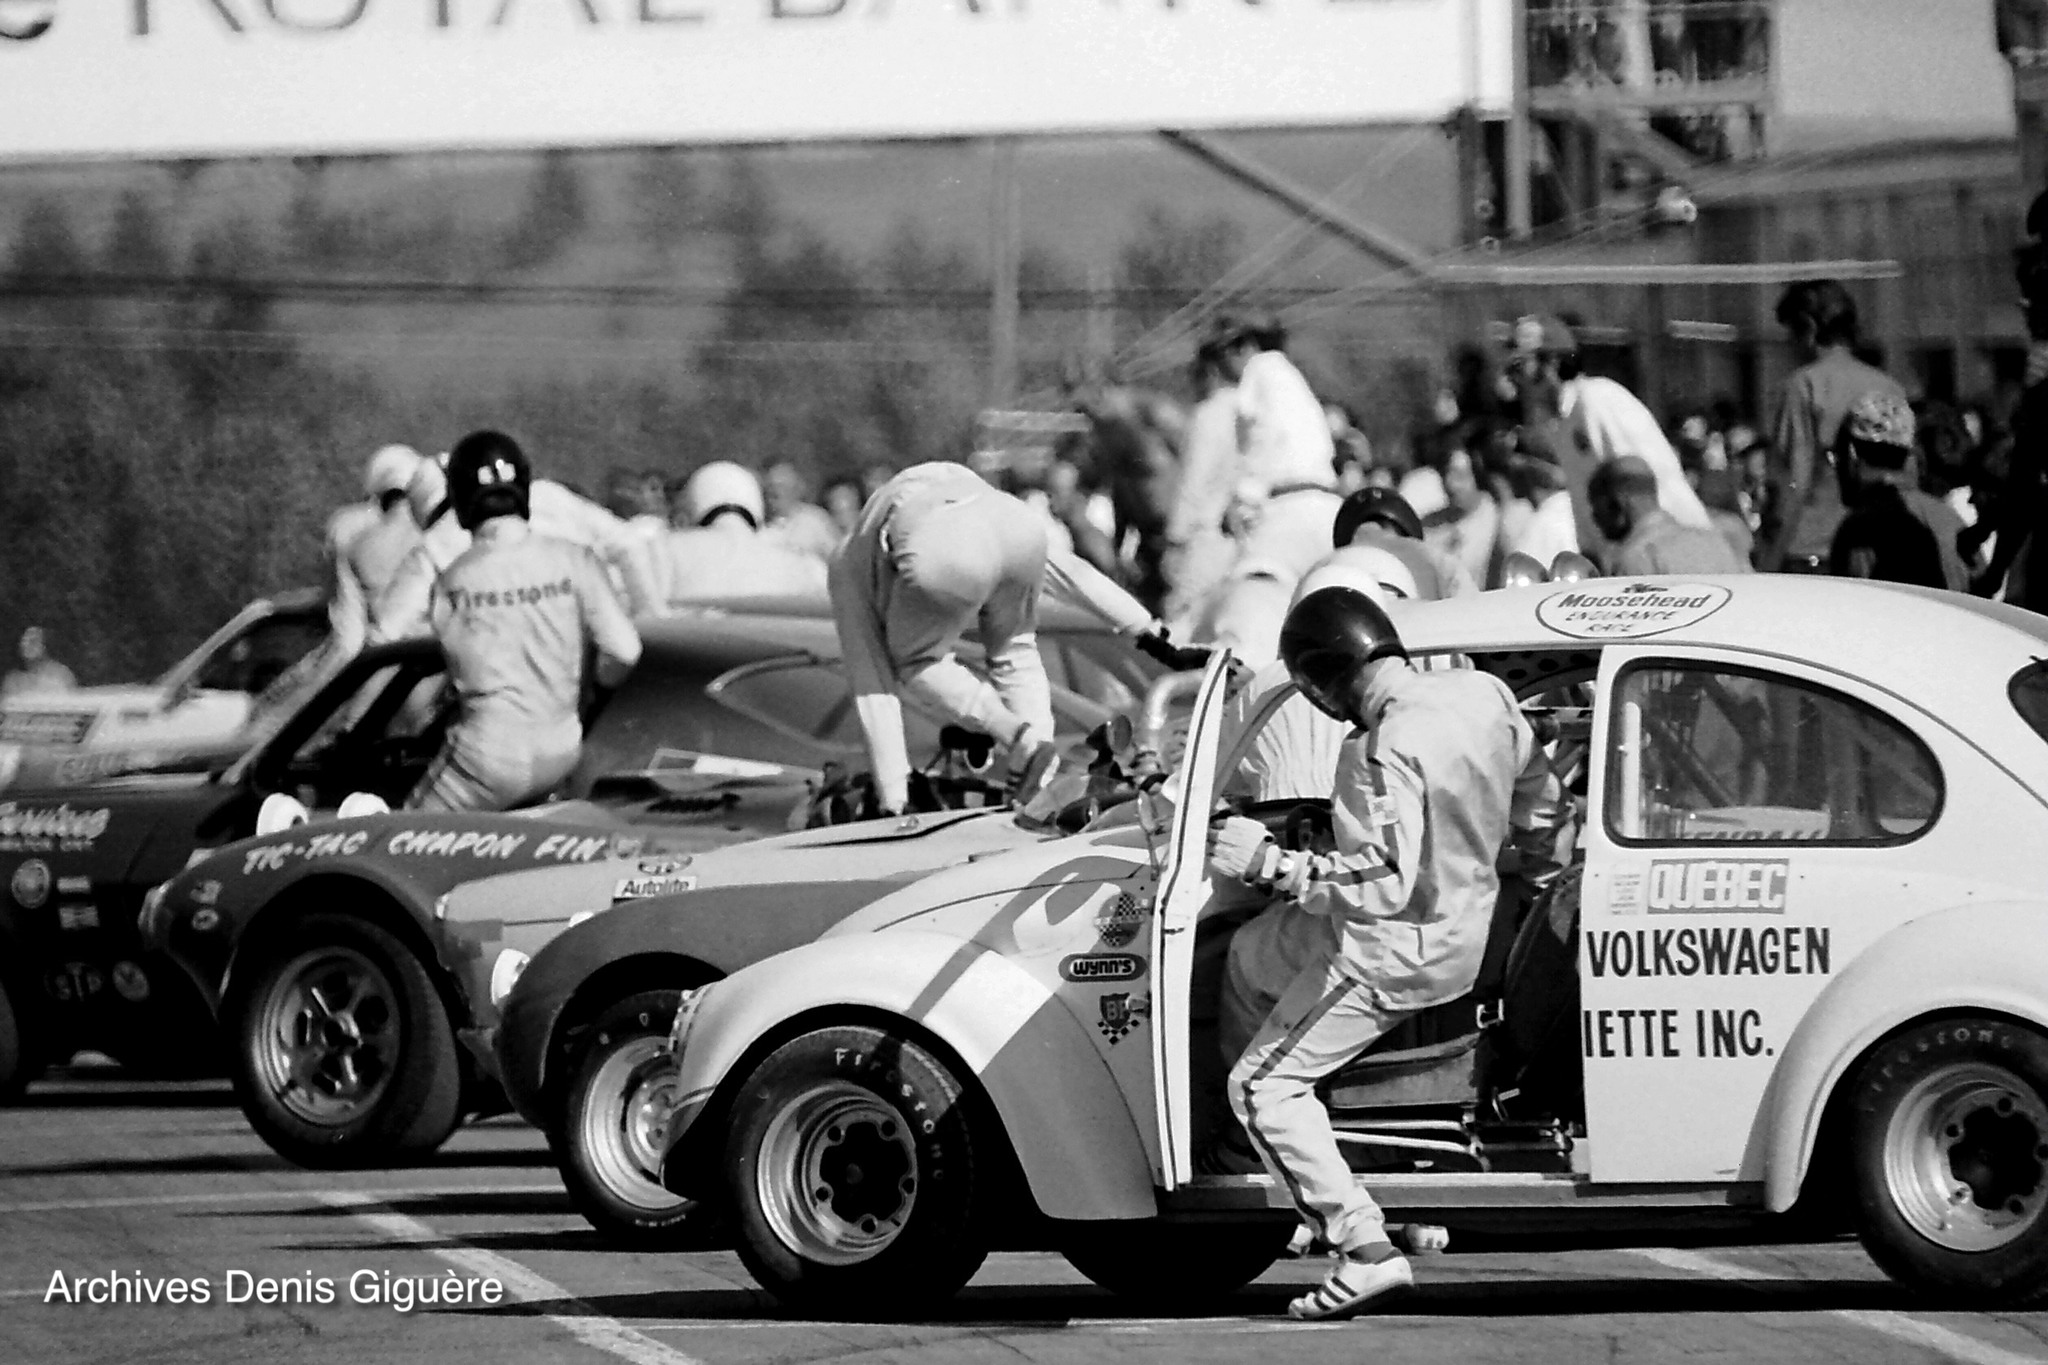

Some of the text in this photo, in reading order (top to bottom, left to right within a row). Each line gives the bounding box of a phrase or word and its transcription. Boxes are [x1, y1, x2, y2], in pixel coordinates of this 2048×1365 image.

[1558, 594, 1711, 609] Moosehead
[1565, 610, 1678, 622] ENDURANCE
[243, 829, 369, 875] TIC-TAC
[387, 830, 527, 859] CHAPON
[533, 834, 607, 862] FIN
[621, 878, 690, 896] Autolite
[1586, 926, 1831, 978] VOLKSWAGEN
[1696, 1008, 1775, 1058] INC.
